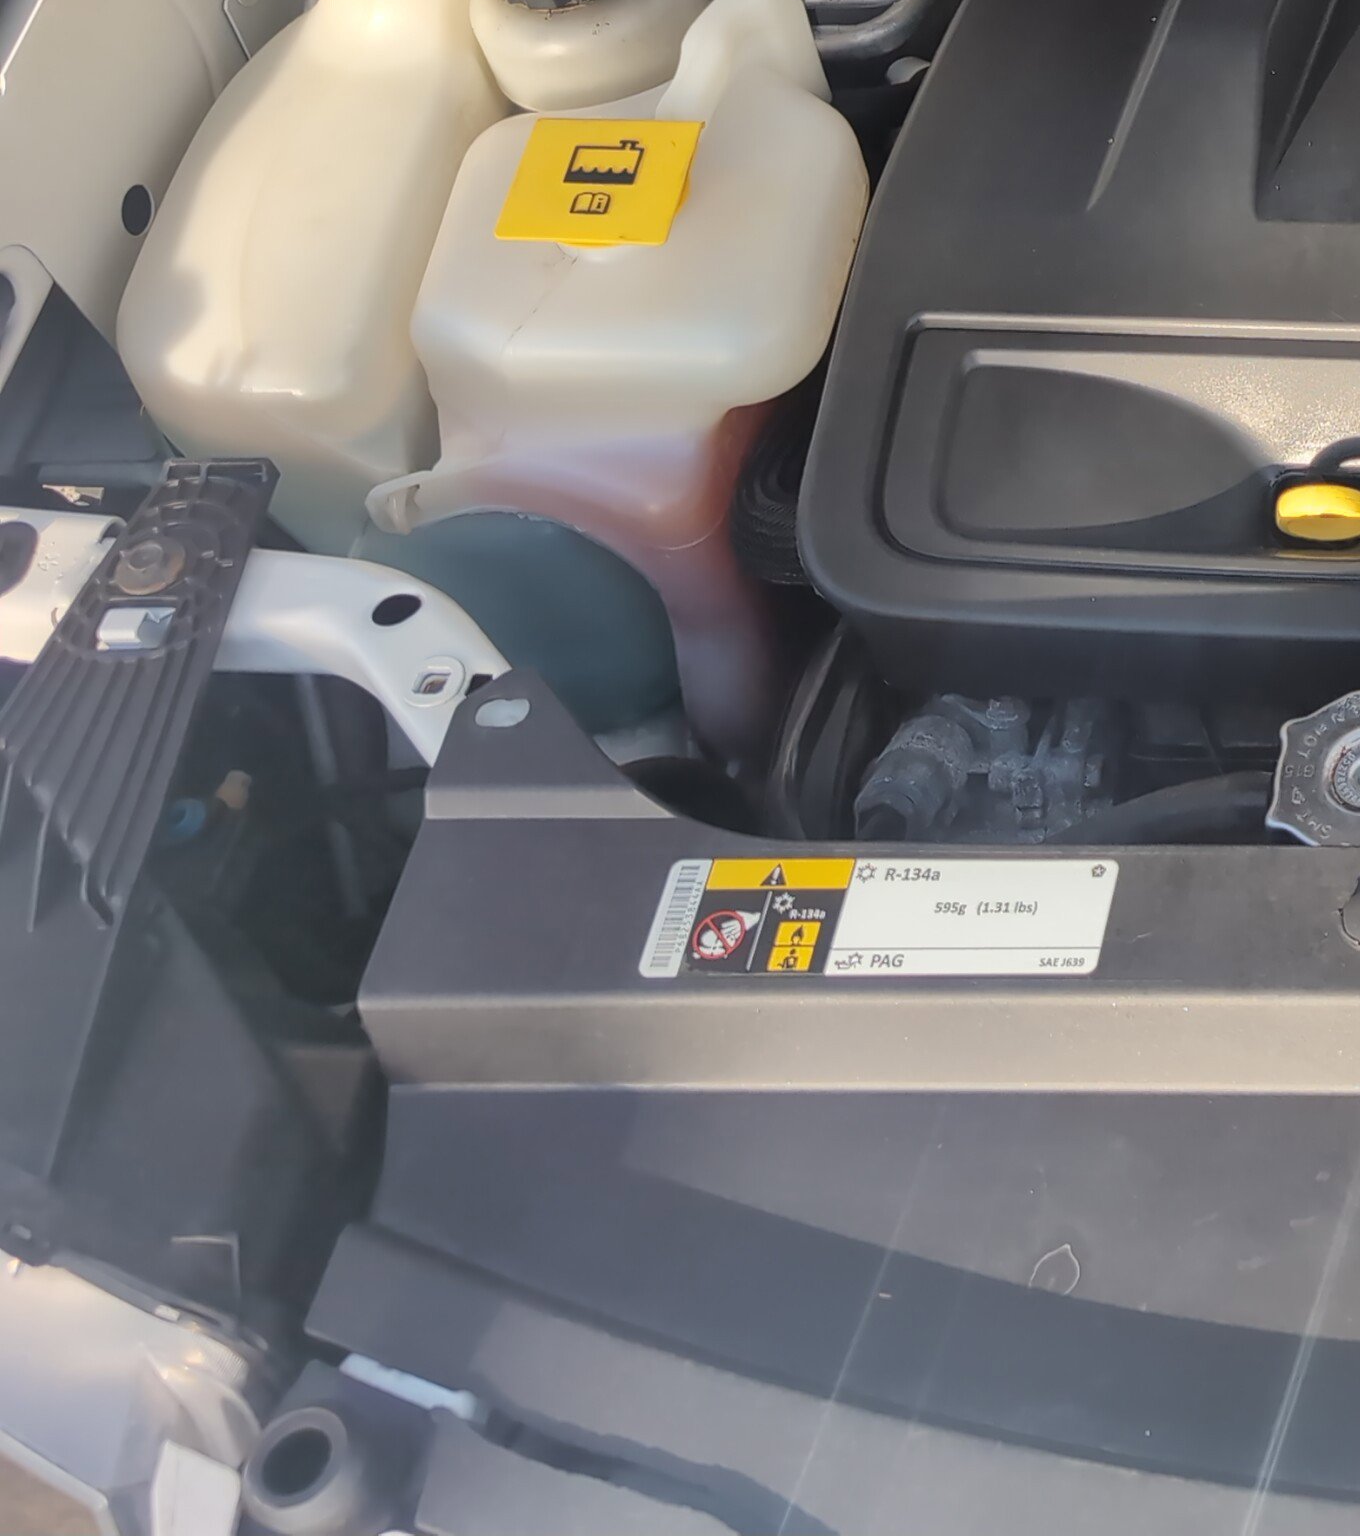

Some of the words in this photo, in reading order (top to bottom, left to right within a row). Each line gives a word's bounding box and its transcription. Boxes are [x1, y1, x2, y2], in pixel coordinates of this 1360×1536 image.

[886, 866, 941, 882] R-134a
[934, 901, 967, 916] 595g
[976, 900, 1009, 916] (1.31
[1013, 900, 1038, 916] lbs)
[870, 954, 904, 968] PAG
[1039, 957, 1059, 967] SAE
[1060, 957, 1085, 967] J639
